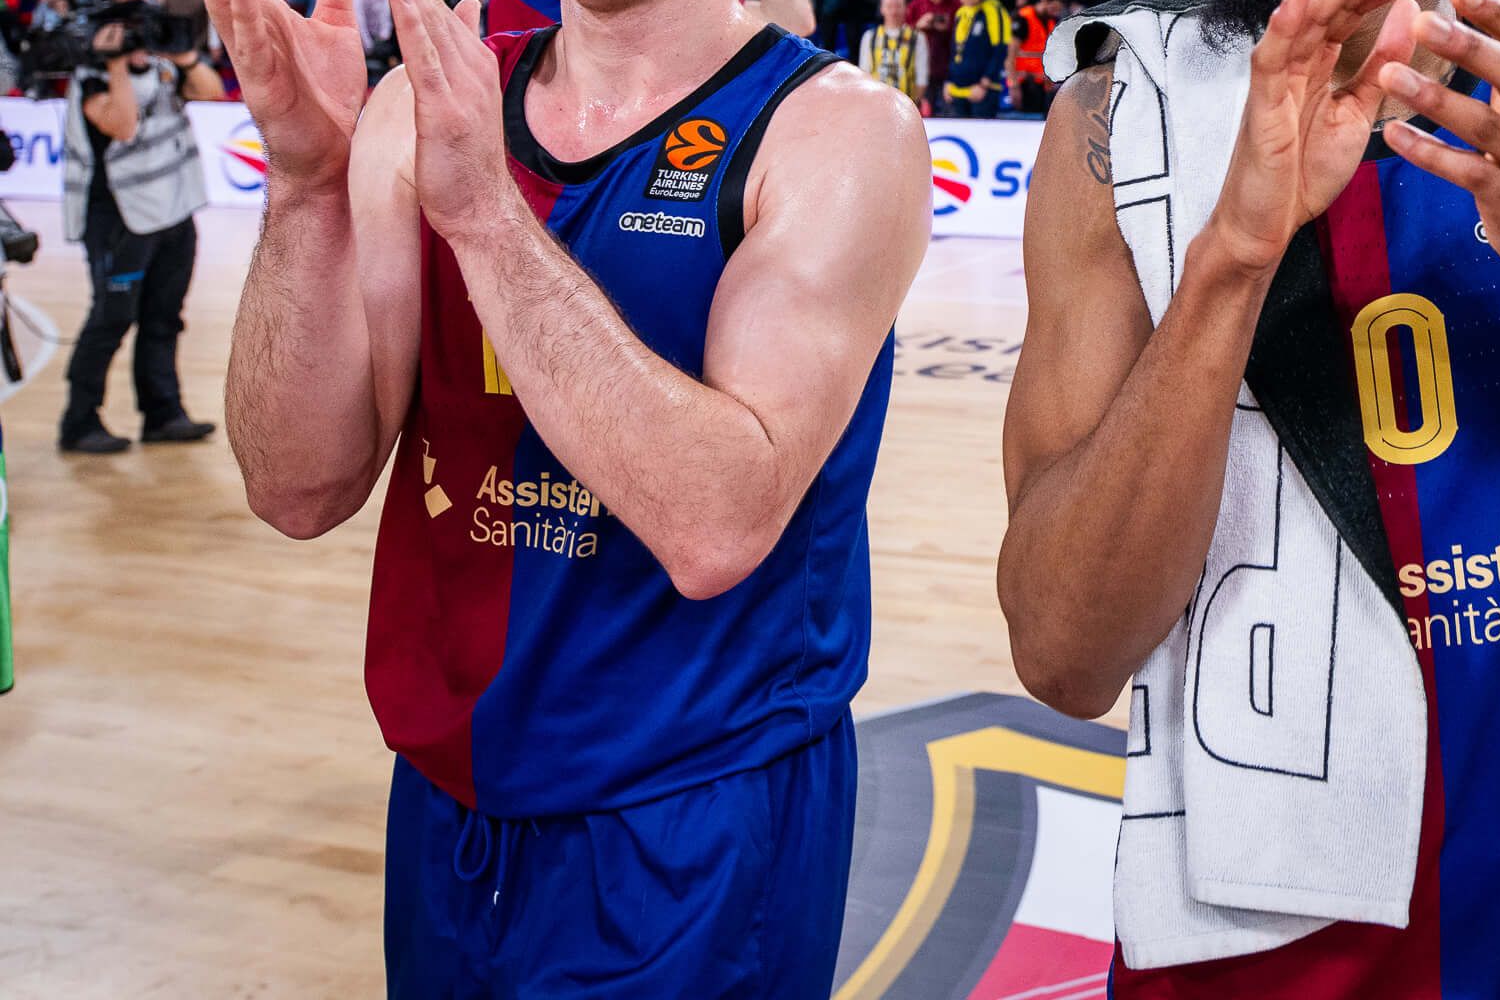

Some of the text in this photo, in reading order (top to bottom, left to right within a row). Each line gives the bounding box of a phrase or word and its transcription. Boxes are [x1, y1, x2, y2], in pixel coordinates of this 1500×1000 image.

[652, 179, 705, 191] AIRLINES
[656, 169, 709, 183] TURKISH
[649, 187, 701, 200] EuroLeague
[619, 211, 706, 238] oneteam
[1350, 293, 1459, 465] 0
[476, 465, 614, 518] Assiste
[470, 506, 598, 559] Sanitària
